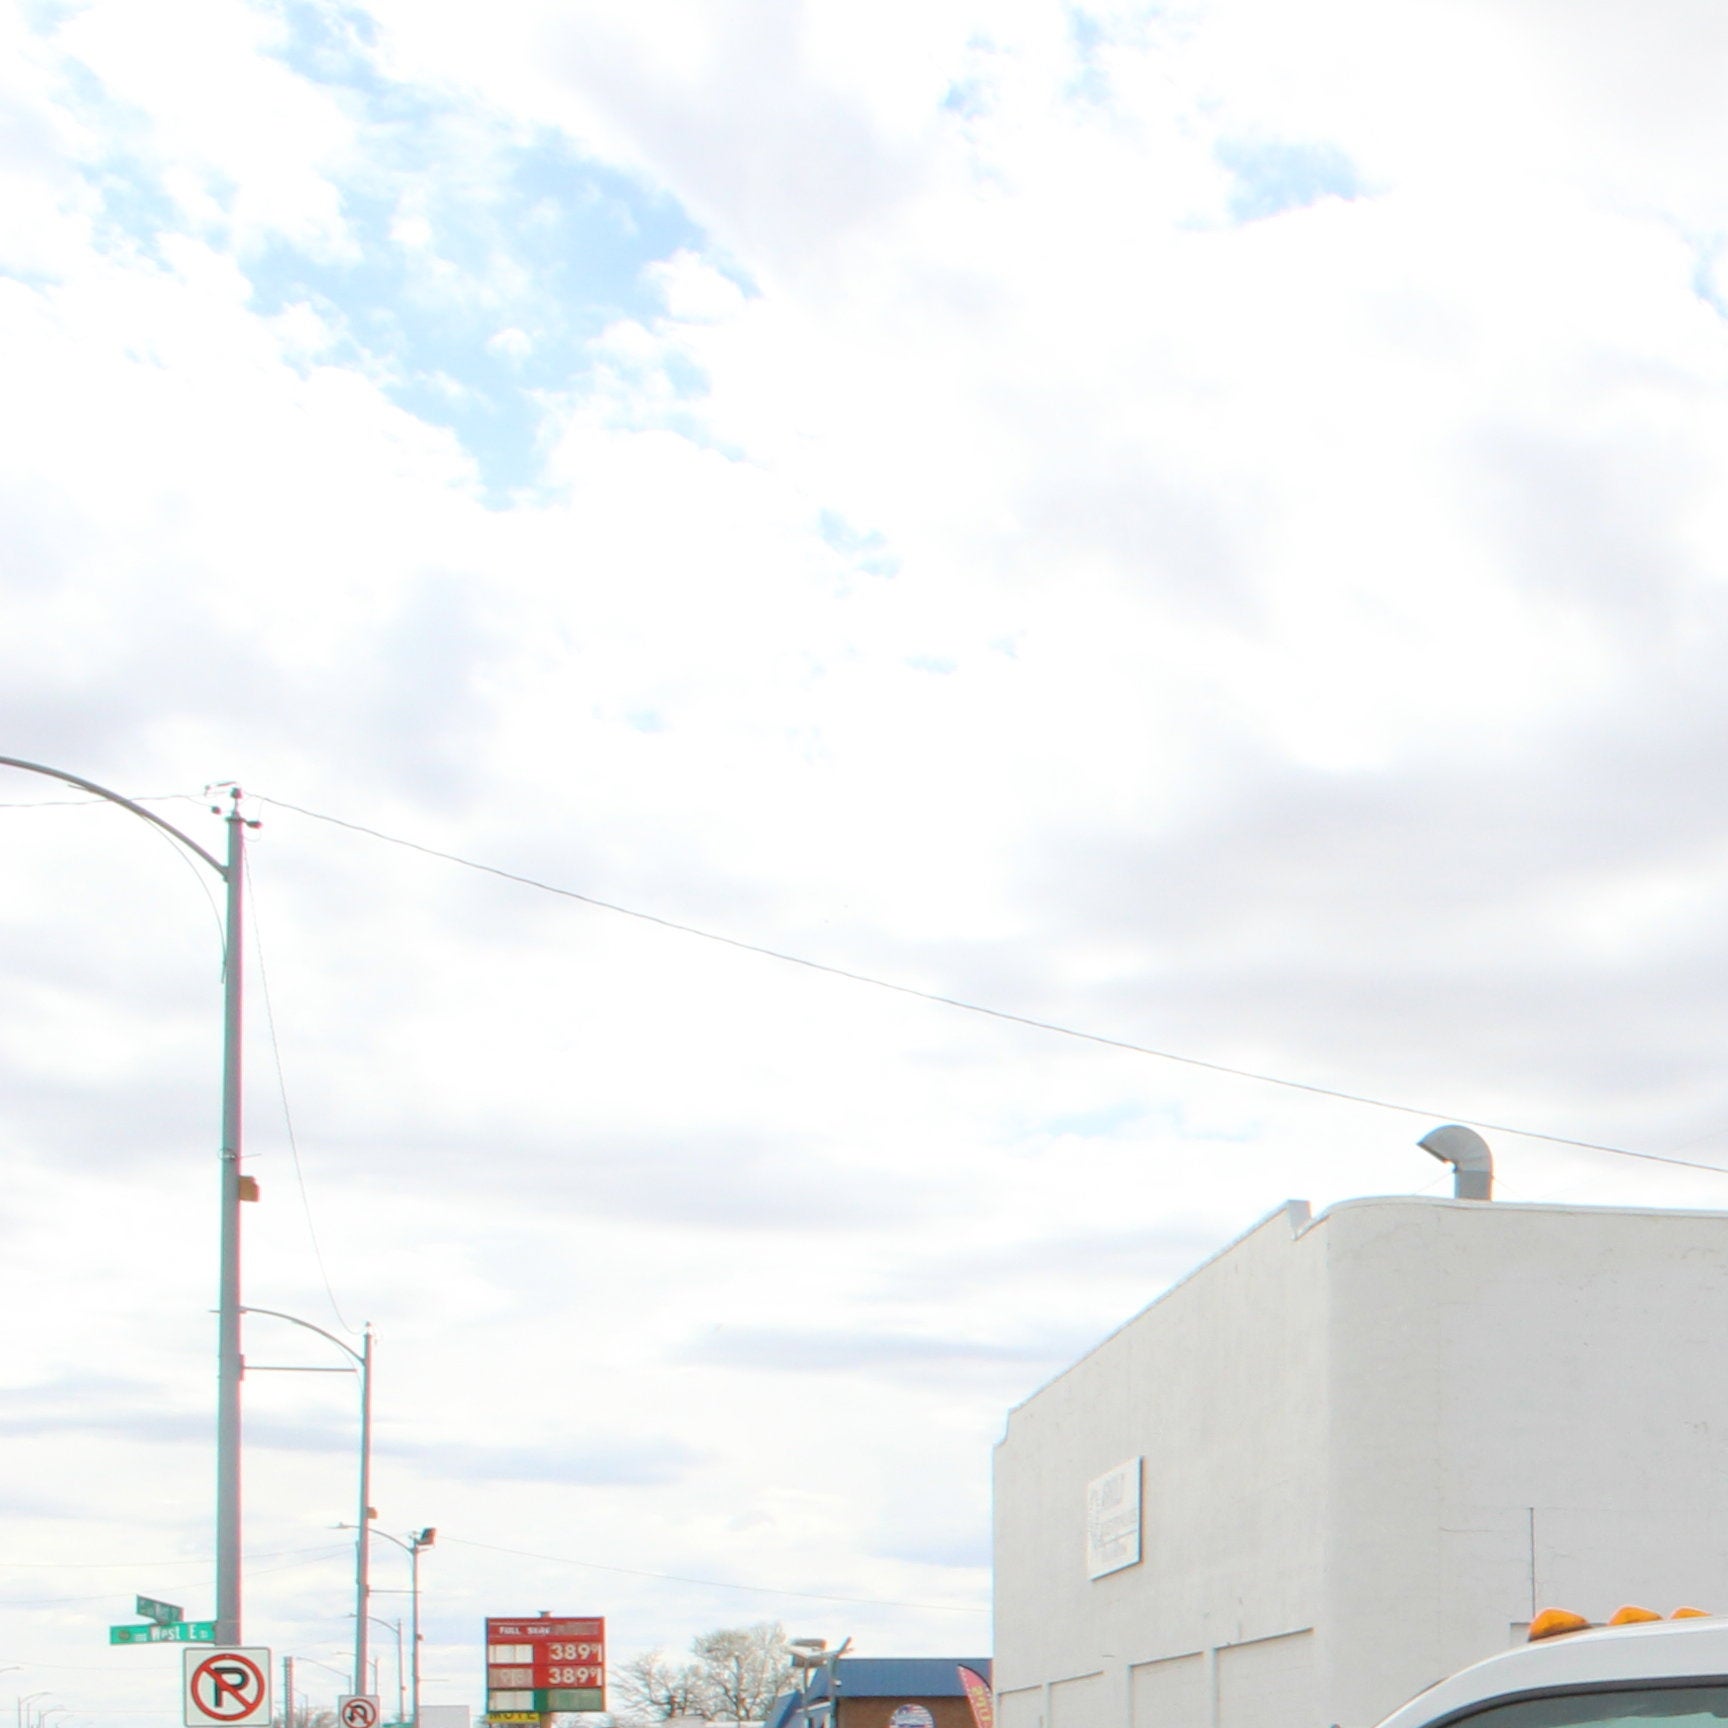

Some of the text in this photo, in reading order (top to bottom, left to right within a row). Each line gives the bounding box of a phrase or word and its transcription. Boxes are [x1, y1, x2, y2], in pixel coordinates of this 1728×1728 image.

[151, 1625, 181, 1641] West
[189, 1623, 198, 1640] E
[489, 1711, 538, 1720] MOTE
